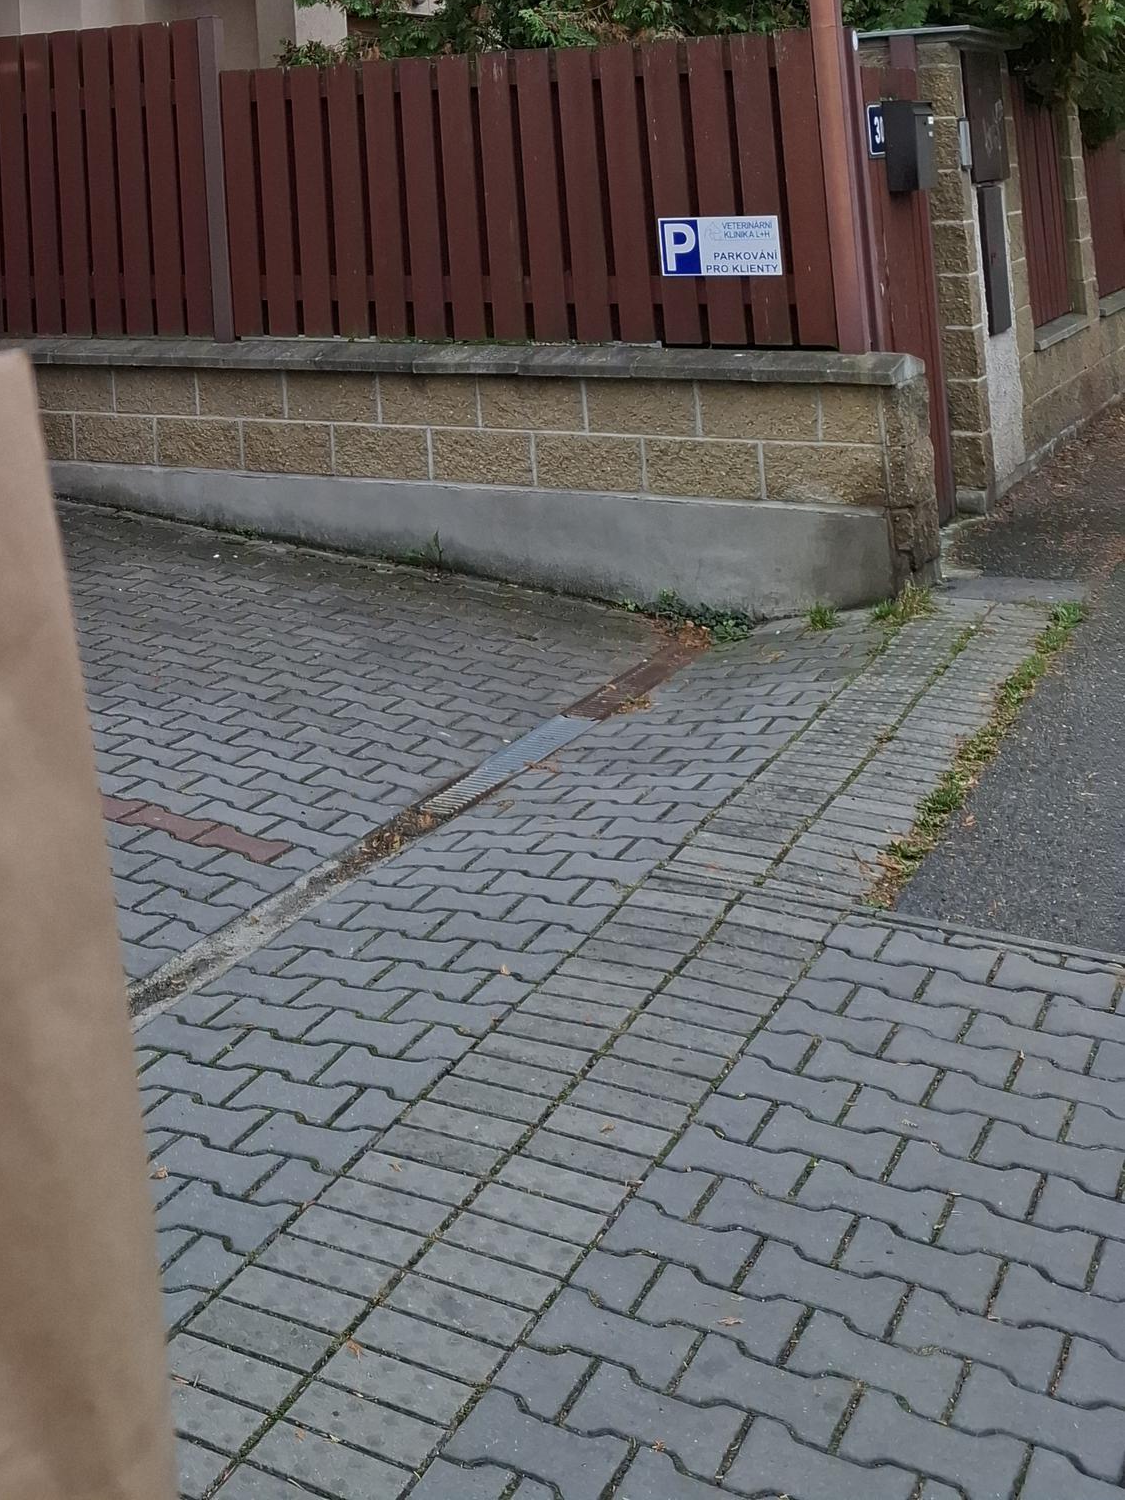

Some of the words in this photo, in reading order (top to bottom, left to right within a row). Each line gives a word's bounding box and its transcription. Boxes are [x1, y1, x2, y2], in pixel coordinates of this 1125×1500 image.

[723, 230, 755, 239] KLINIKA
[756, 230, 771, 239] L+H
[663, 223, 696, 272] P
[713, 249, 778, 260] PARKOVÁNÍ
[706, 264, 729, 273] PRO
[732, 264, 778, 273] KLIENTY
